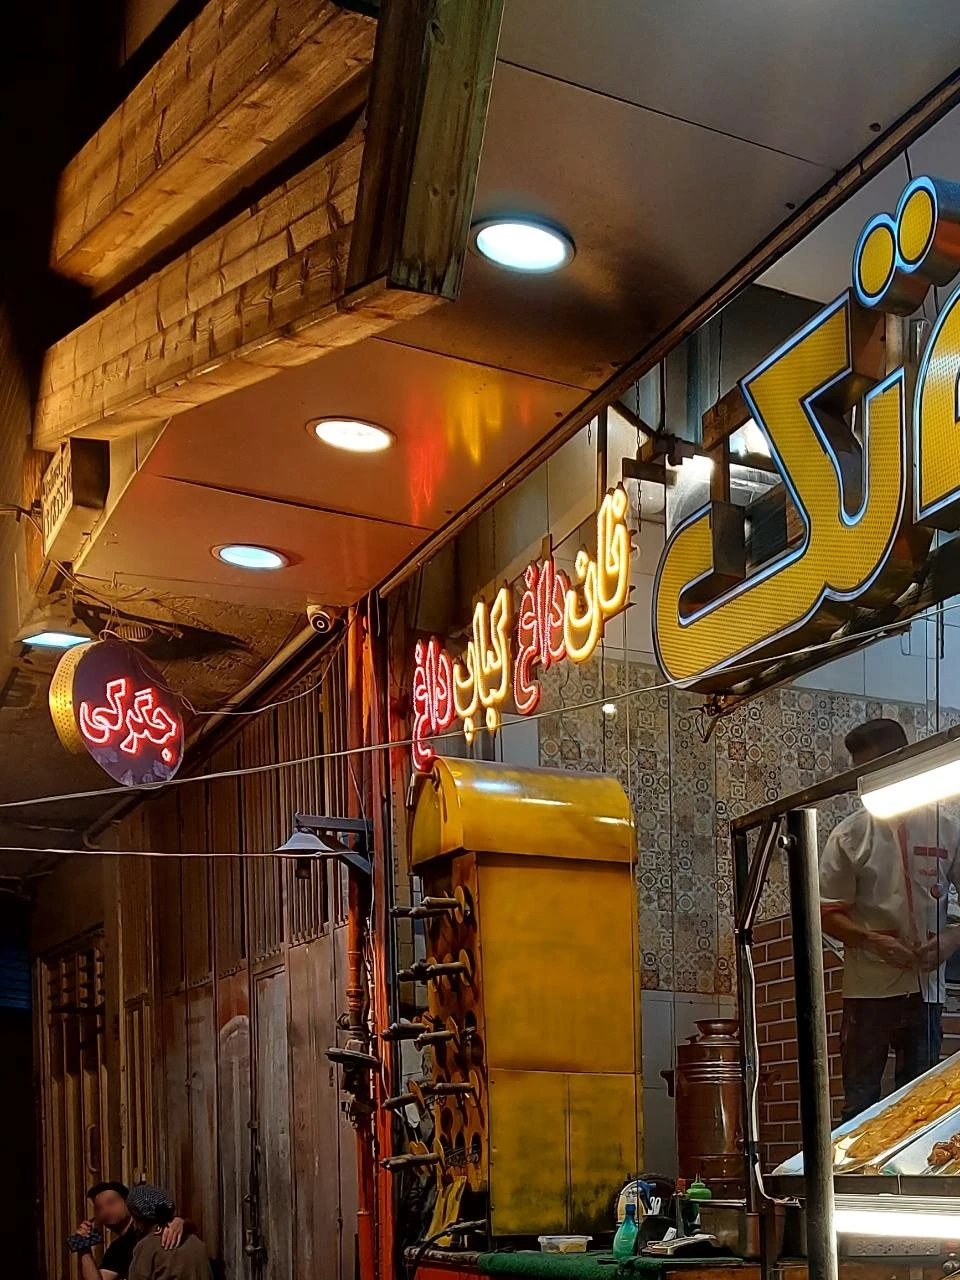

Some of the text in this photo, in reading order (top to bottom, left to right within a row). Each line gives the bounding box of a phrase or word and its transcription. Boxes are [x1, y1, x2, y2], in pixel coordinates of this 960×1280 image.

[412, 481, 630, 770] نان داغ کباب داغ
[80, 678, 177, 762] جگرکی
